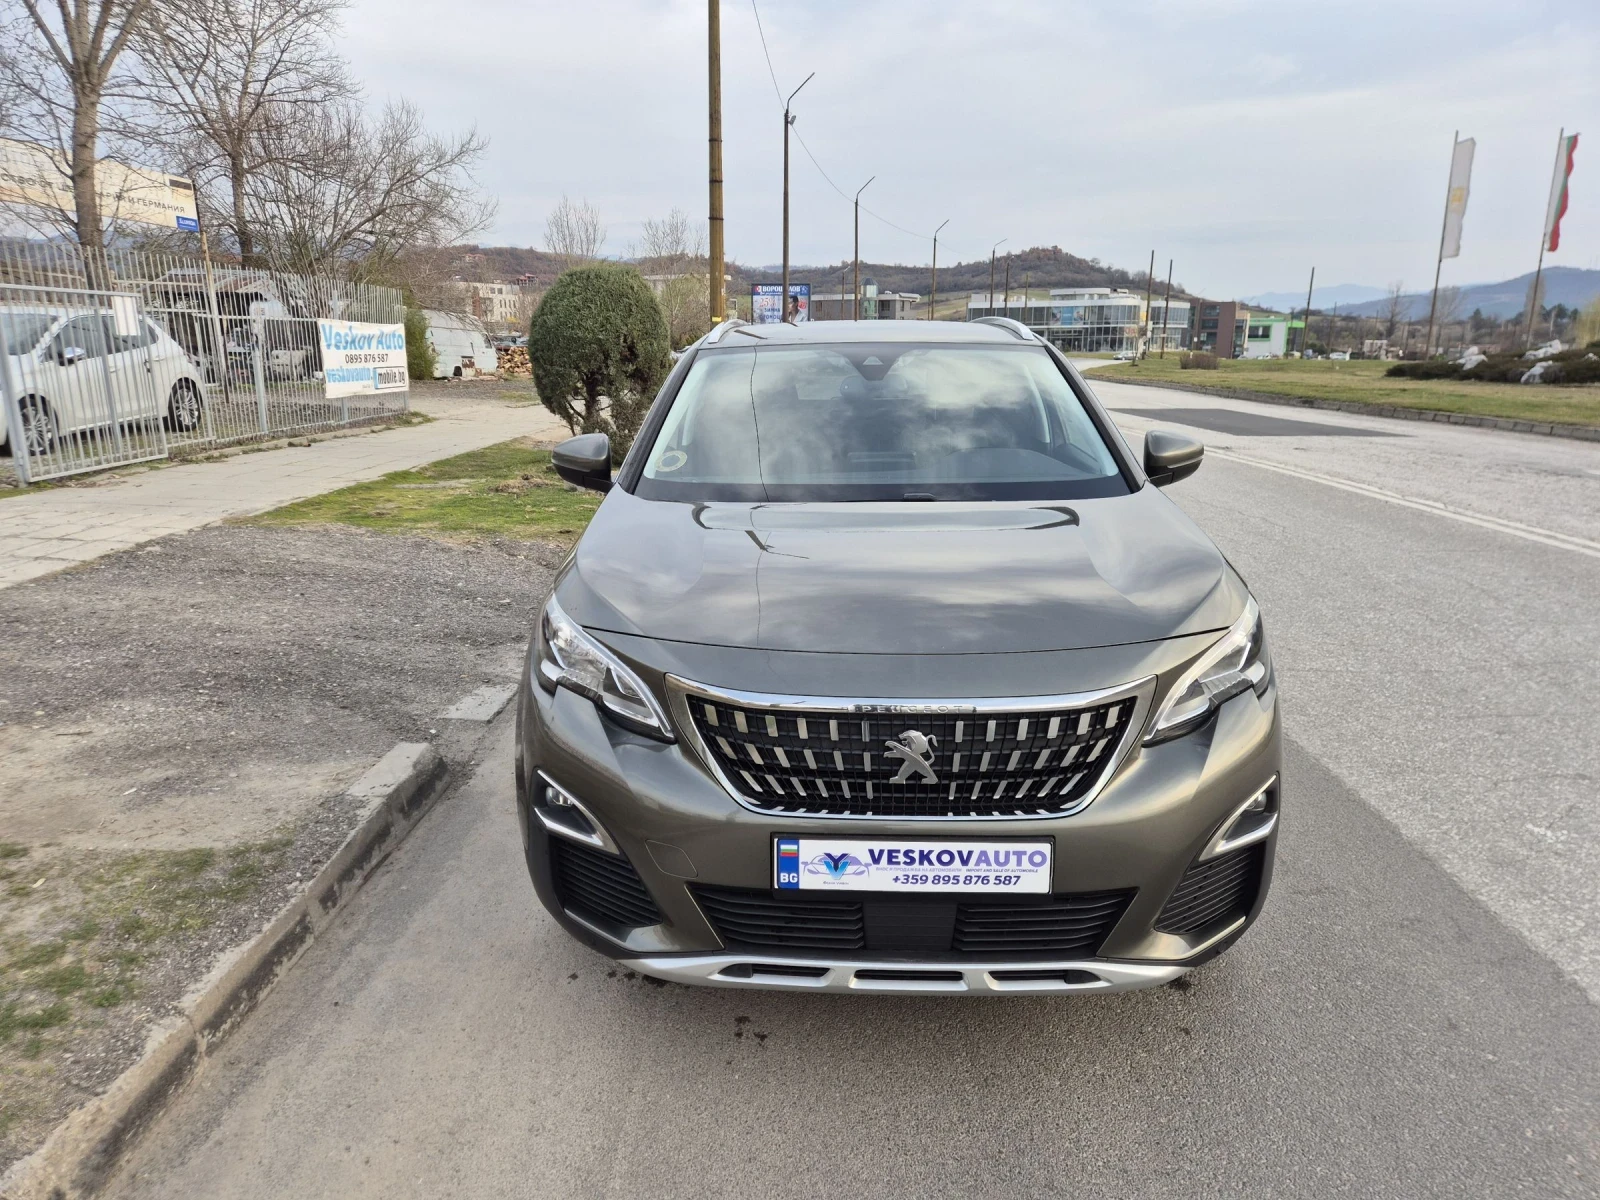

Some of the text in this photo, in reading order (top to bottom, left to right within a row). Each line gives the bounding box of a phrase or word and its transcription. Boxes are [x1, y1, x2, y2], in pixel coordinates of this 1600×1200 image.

[137, 198, 185, 213] ГЕРМАНИЯ
[321, 324, 404, 350] Veskov Auto
[345, 353, 389, 364] 0895 876 587
[862, 705, 962, 713] PEUGEOT
[868, 848, 1047, 868] VESKOVAUTO
[780, 873, 798, 883] BG
[892, 874, 1021, 886] +359 895 876 587
